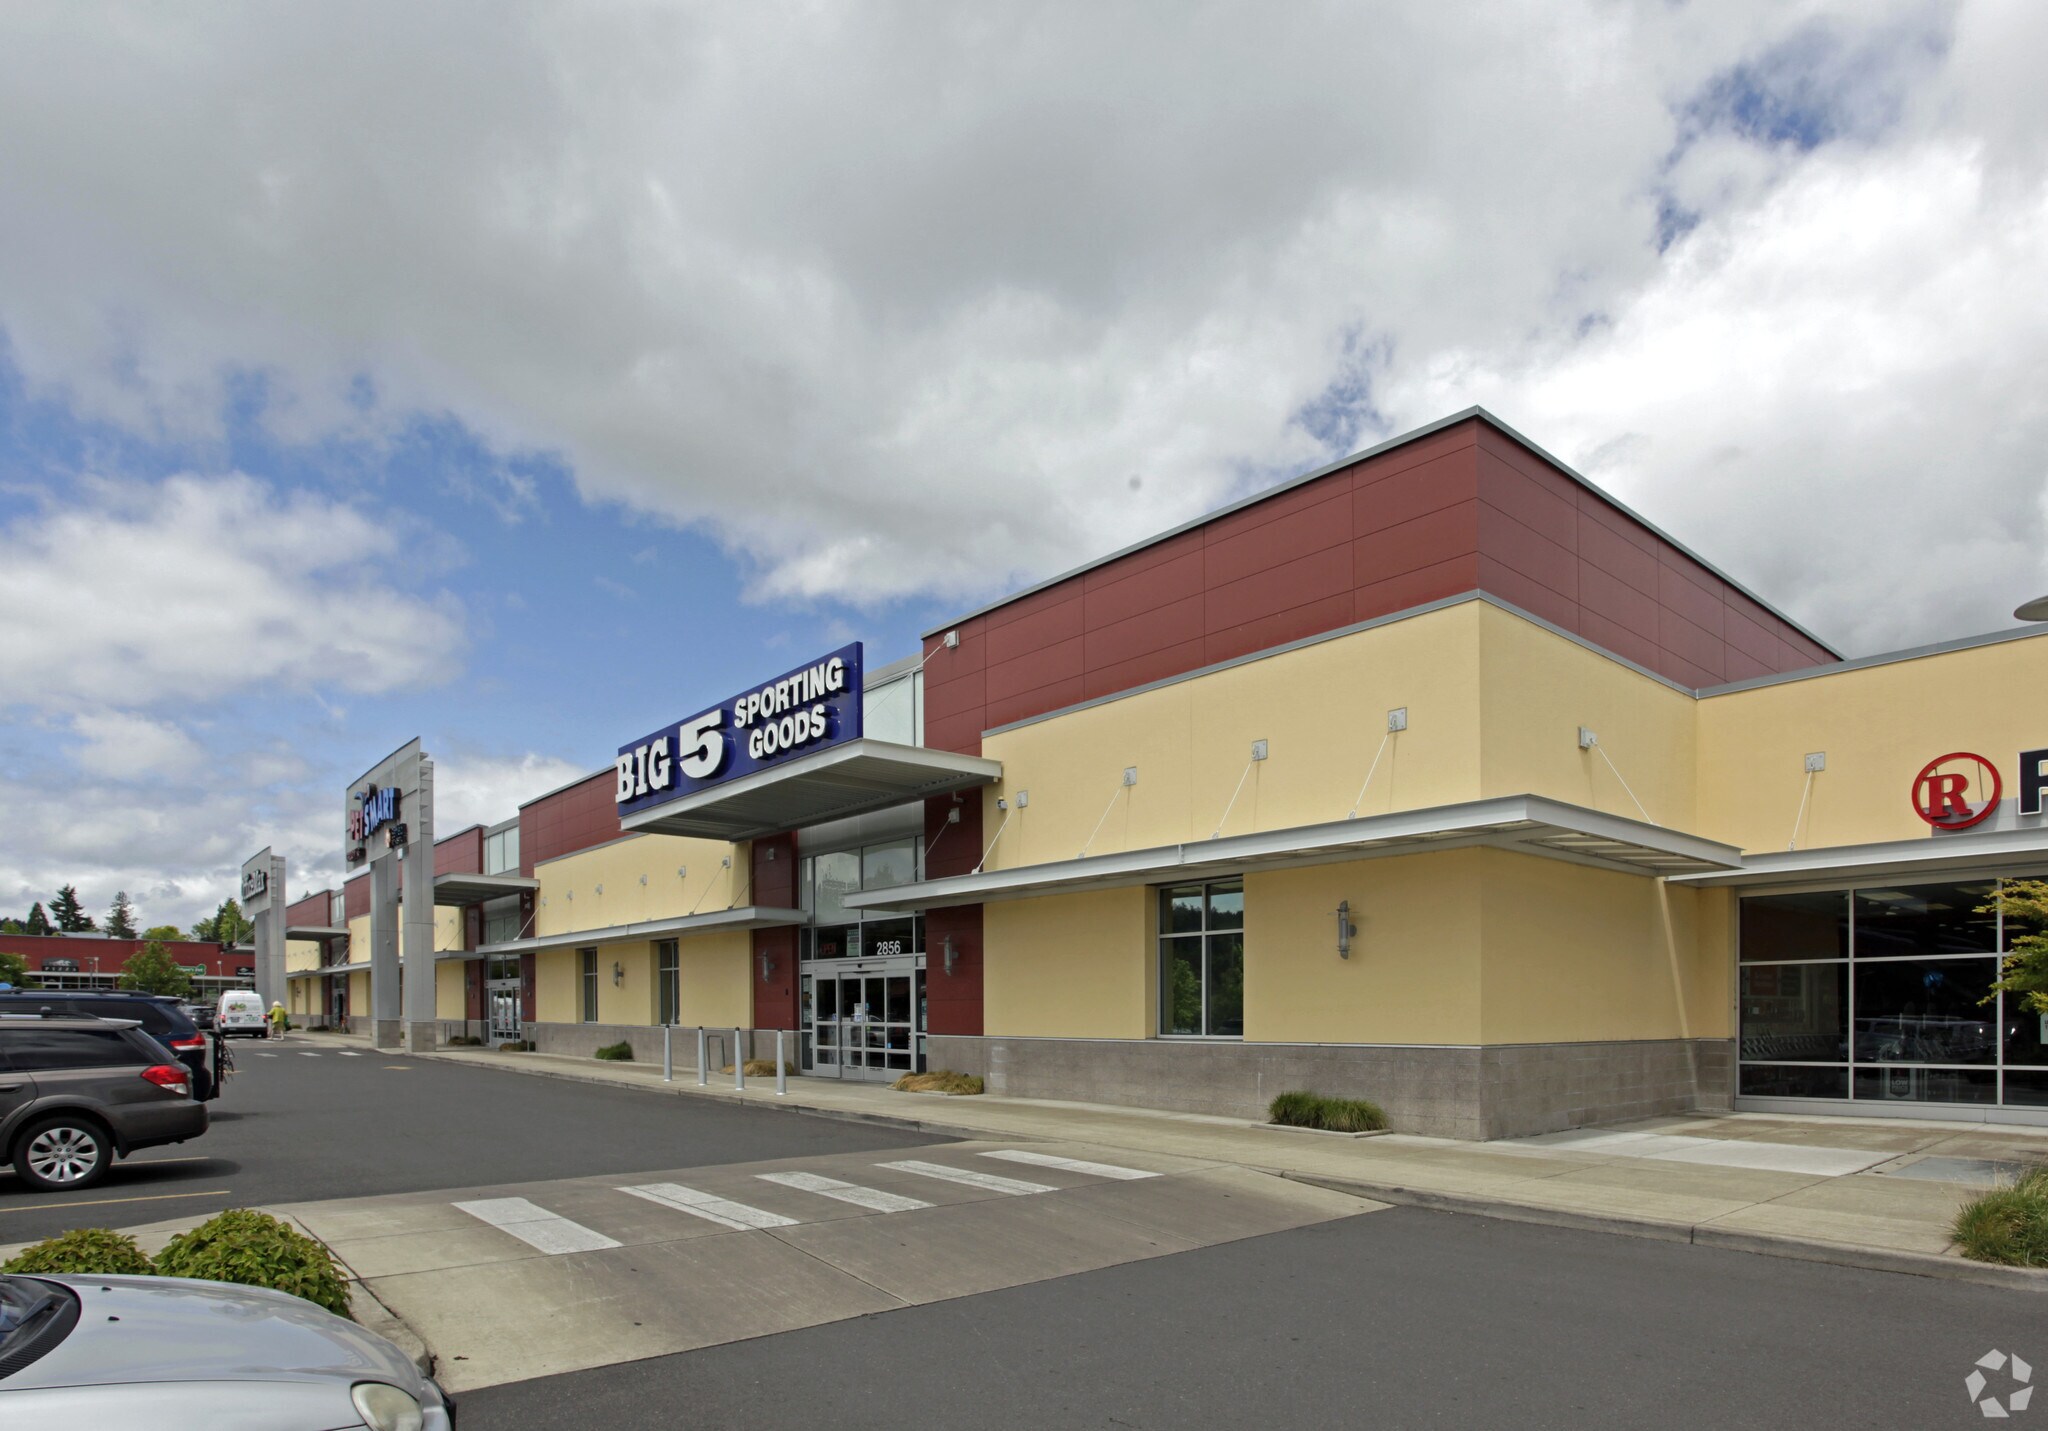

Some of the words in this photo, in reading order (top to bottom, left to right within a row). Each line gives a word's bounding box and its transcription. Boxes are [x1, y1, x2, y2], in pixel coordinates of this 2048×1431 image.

[734, 656, 844, 729] SPORTING
[615, 735, 672, 804] BIG
[679, 708, 725, 779] 5
[748, 703, 827, 760] GOODS
[876, 940, 901, 956] 2856
